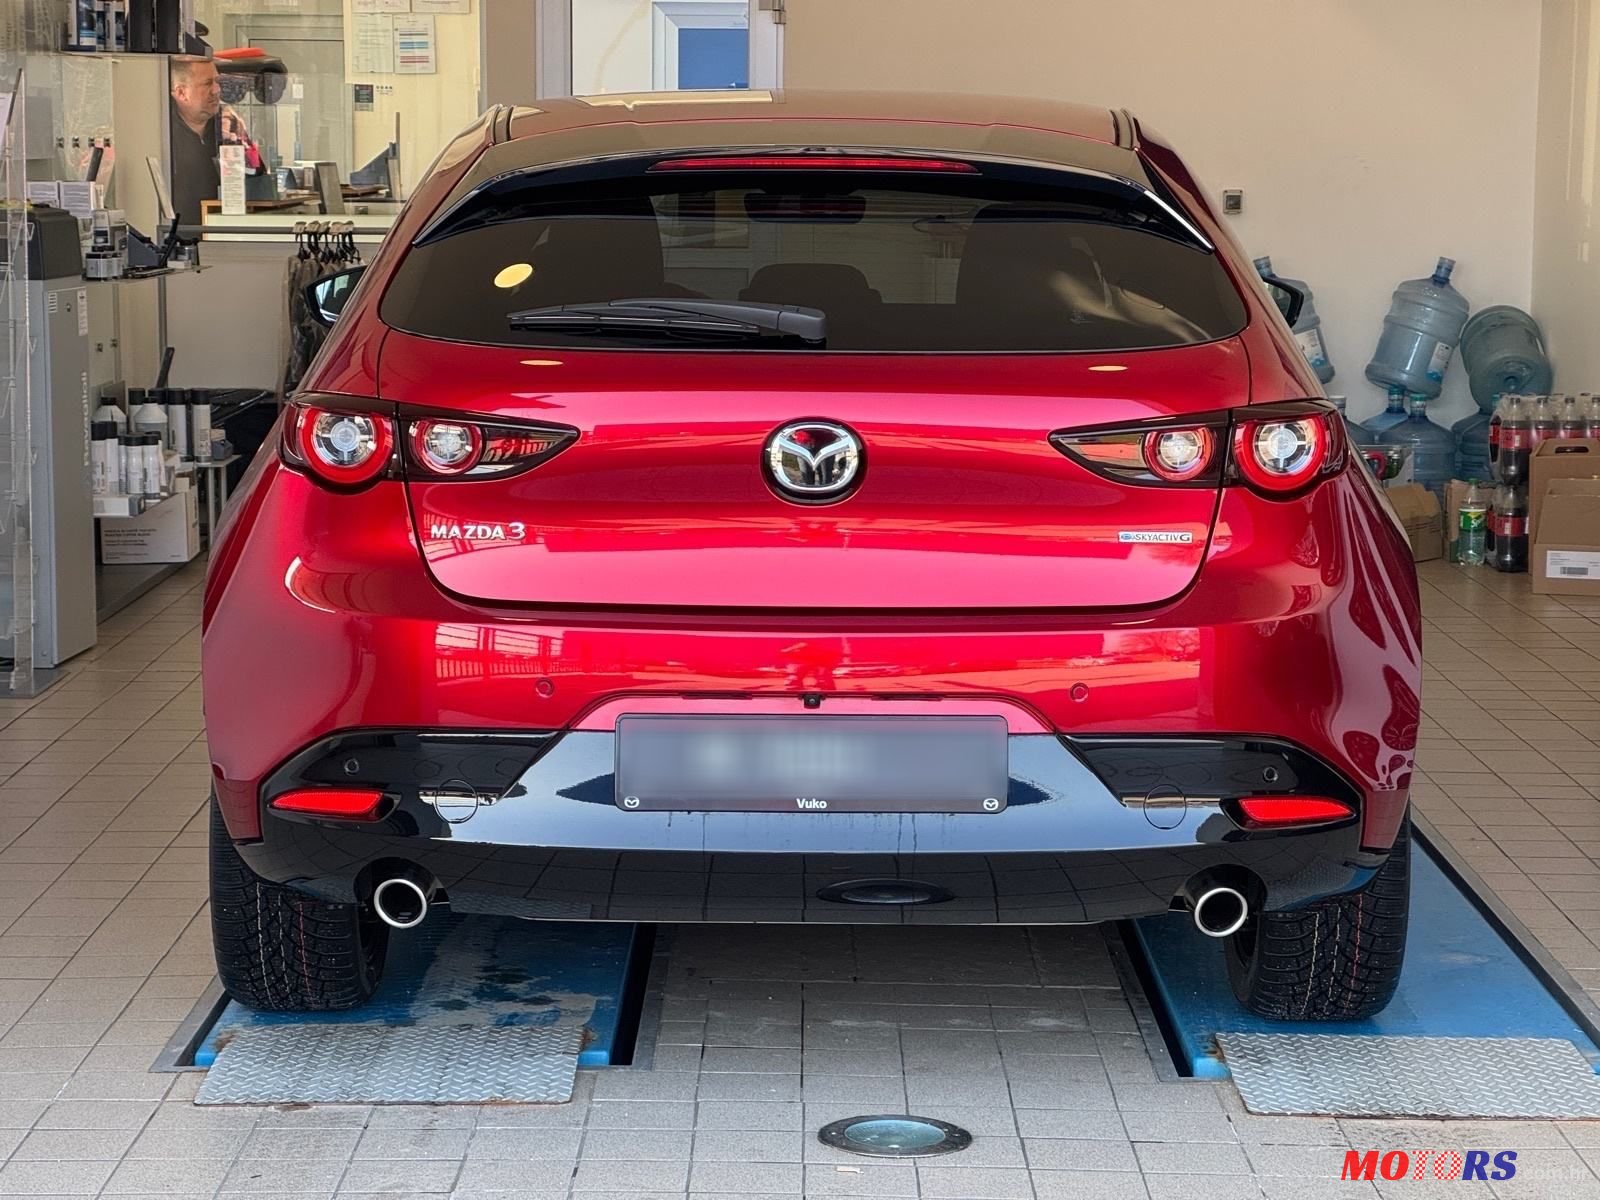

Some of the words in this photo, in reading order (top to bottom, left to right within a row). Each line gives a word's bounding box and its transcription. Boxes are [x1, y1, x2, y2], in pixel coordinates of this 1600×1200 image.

[430, 524, 505, 540] MAZDA
[508, 521, 526, 540] 3
[795, 797, 828, 809] Vuko
